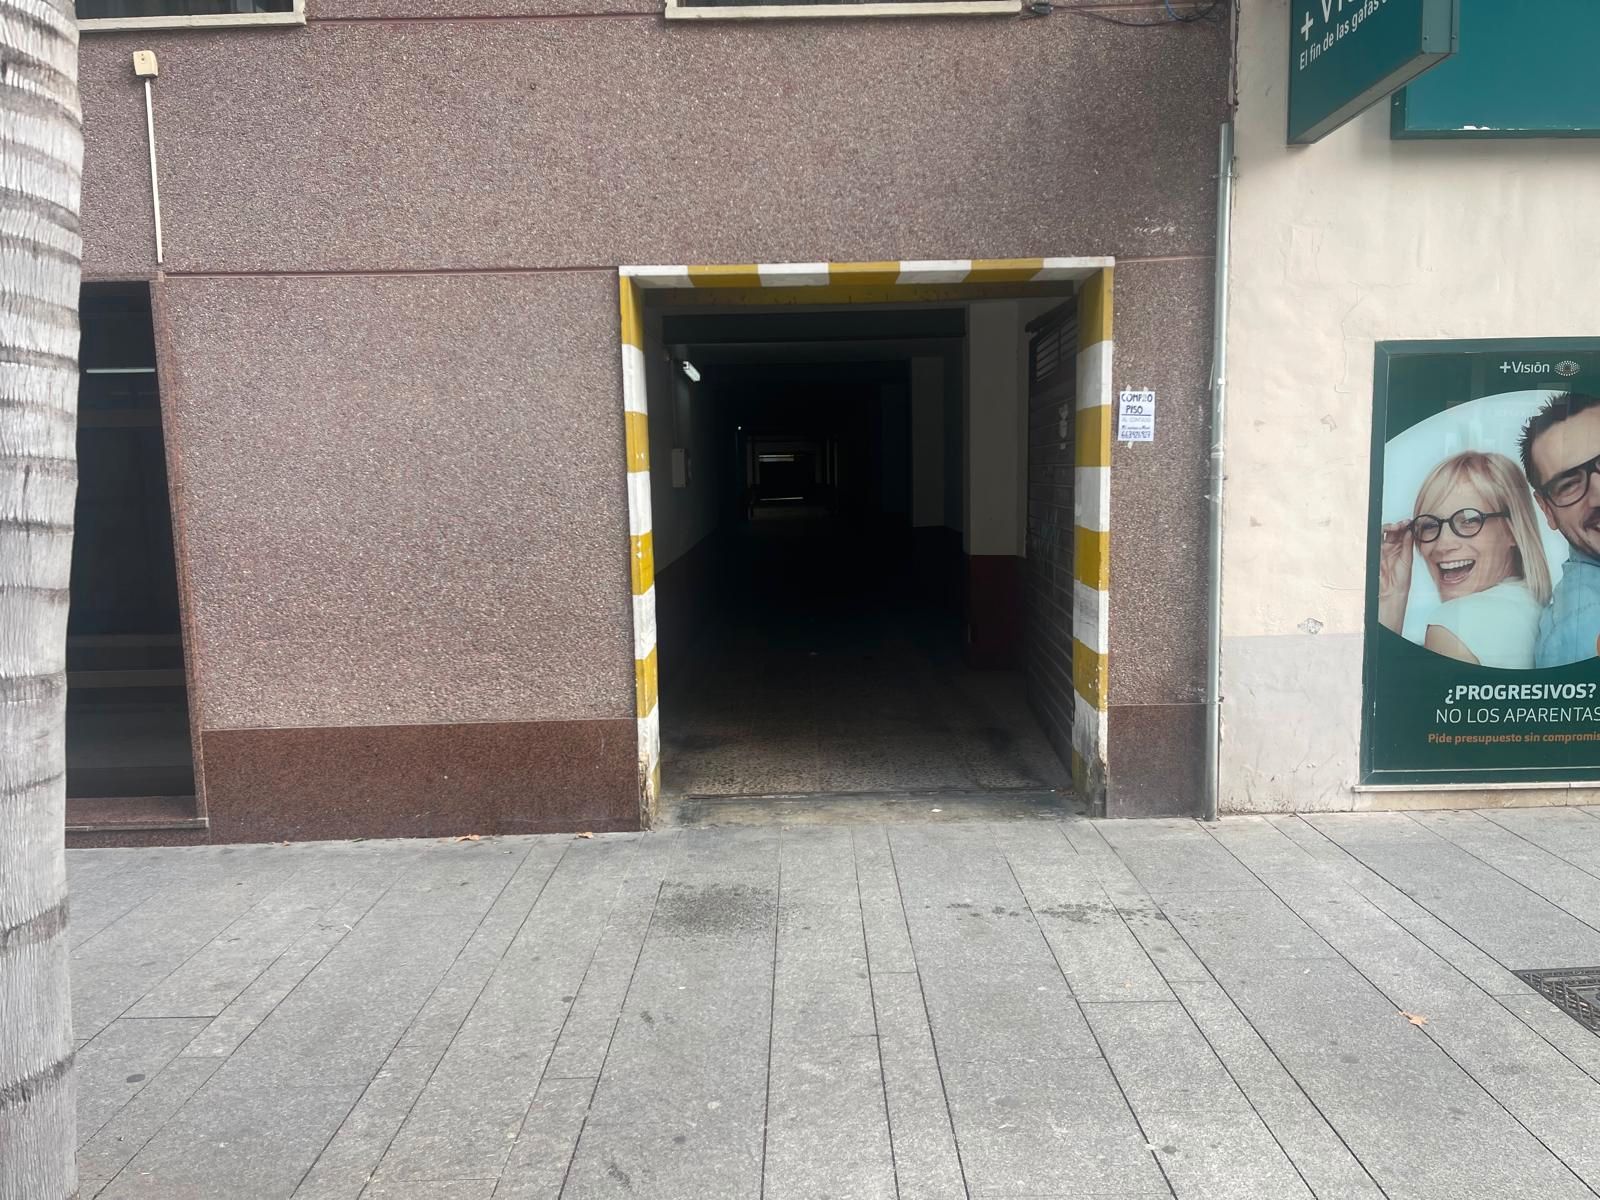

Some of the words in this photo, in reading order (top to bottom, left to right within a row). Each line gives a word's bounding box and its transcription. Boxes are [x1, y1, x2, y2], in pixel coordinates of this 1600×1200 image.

[1300, 49, 1308, 71] El
[1310, 42, 1321, 62] fin
[1323, 32, 1334, 51] de
[1336, 19, 1350, 41] las
[1352, 0, 1379, 32] gafas
[1126, 405, 1143, 414] PISO
[1445, 683, 1597, 704] ¿PROGRESIVOS?
[1436, 709, 1462, 723] NO
[1467, 708, 1500, 723] LOS
[1504, 706, 1600, 722] APARENTAS
[1428, 733, 1452, 743] Pide
[1455, 733, 1522, 745] presupuesto
[1524, 732, 1540, 742] sin
